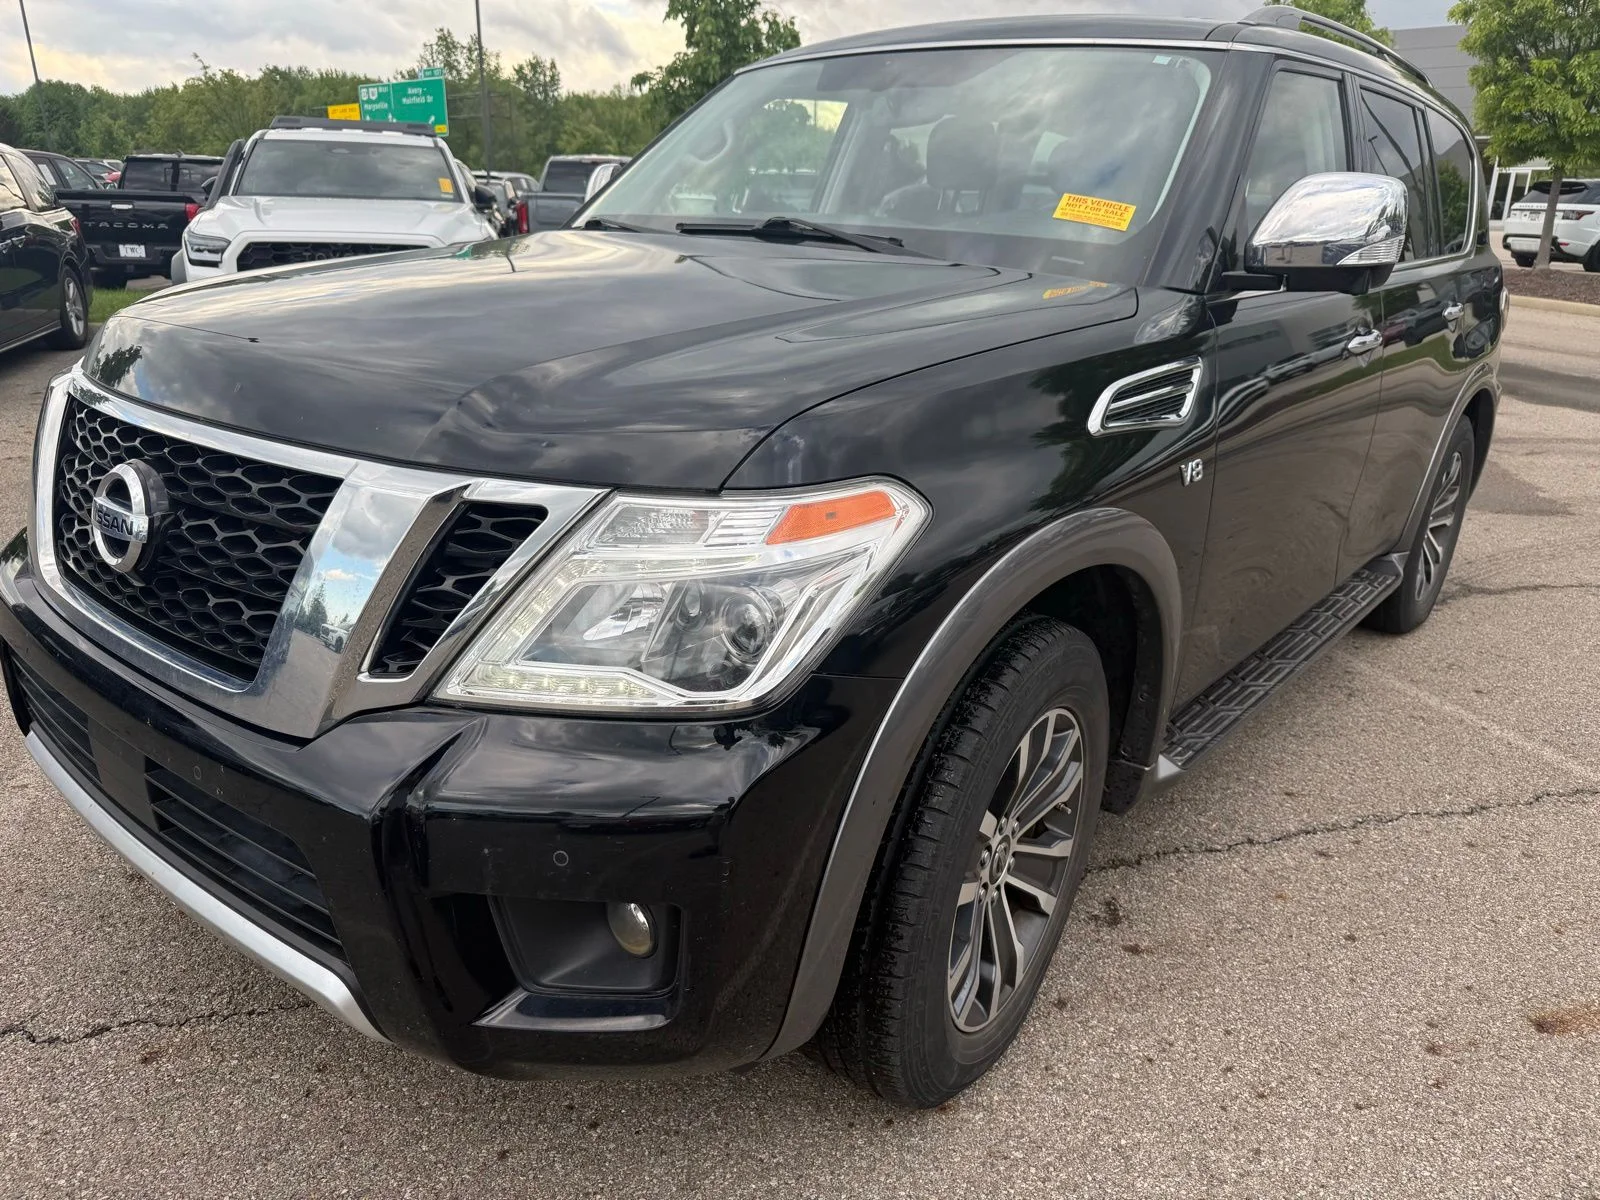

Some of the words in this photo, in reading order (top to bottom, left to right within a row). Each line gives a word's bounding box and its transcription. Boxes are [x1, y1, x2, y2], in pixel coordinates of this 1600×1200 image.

[408, 87, 422, 96] Avery
[1067, 195, 1088, 204] THIS
[1091, 199, 1131, 213] VEHICLE
[1084, 205, 1102, 213] FOR
[1103, 209, 1126, 218] SALE
[84, 221, 169, 229] TACOMA
[1180, 458, 1203, 487] V8
[94, 503, 134, 536] SSAN
